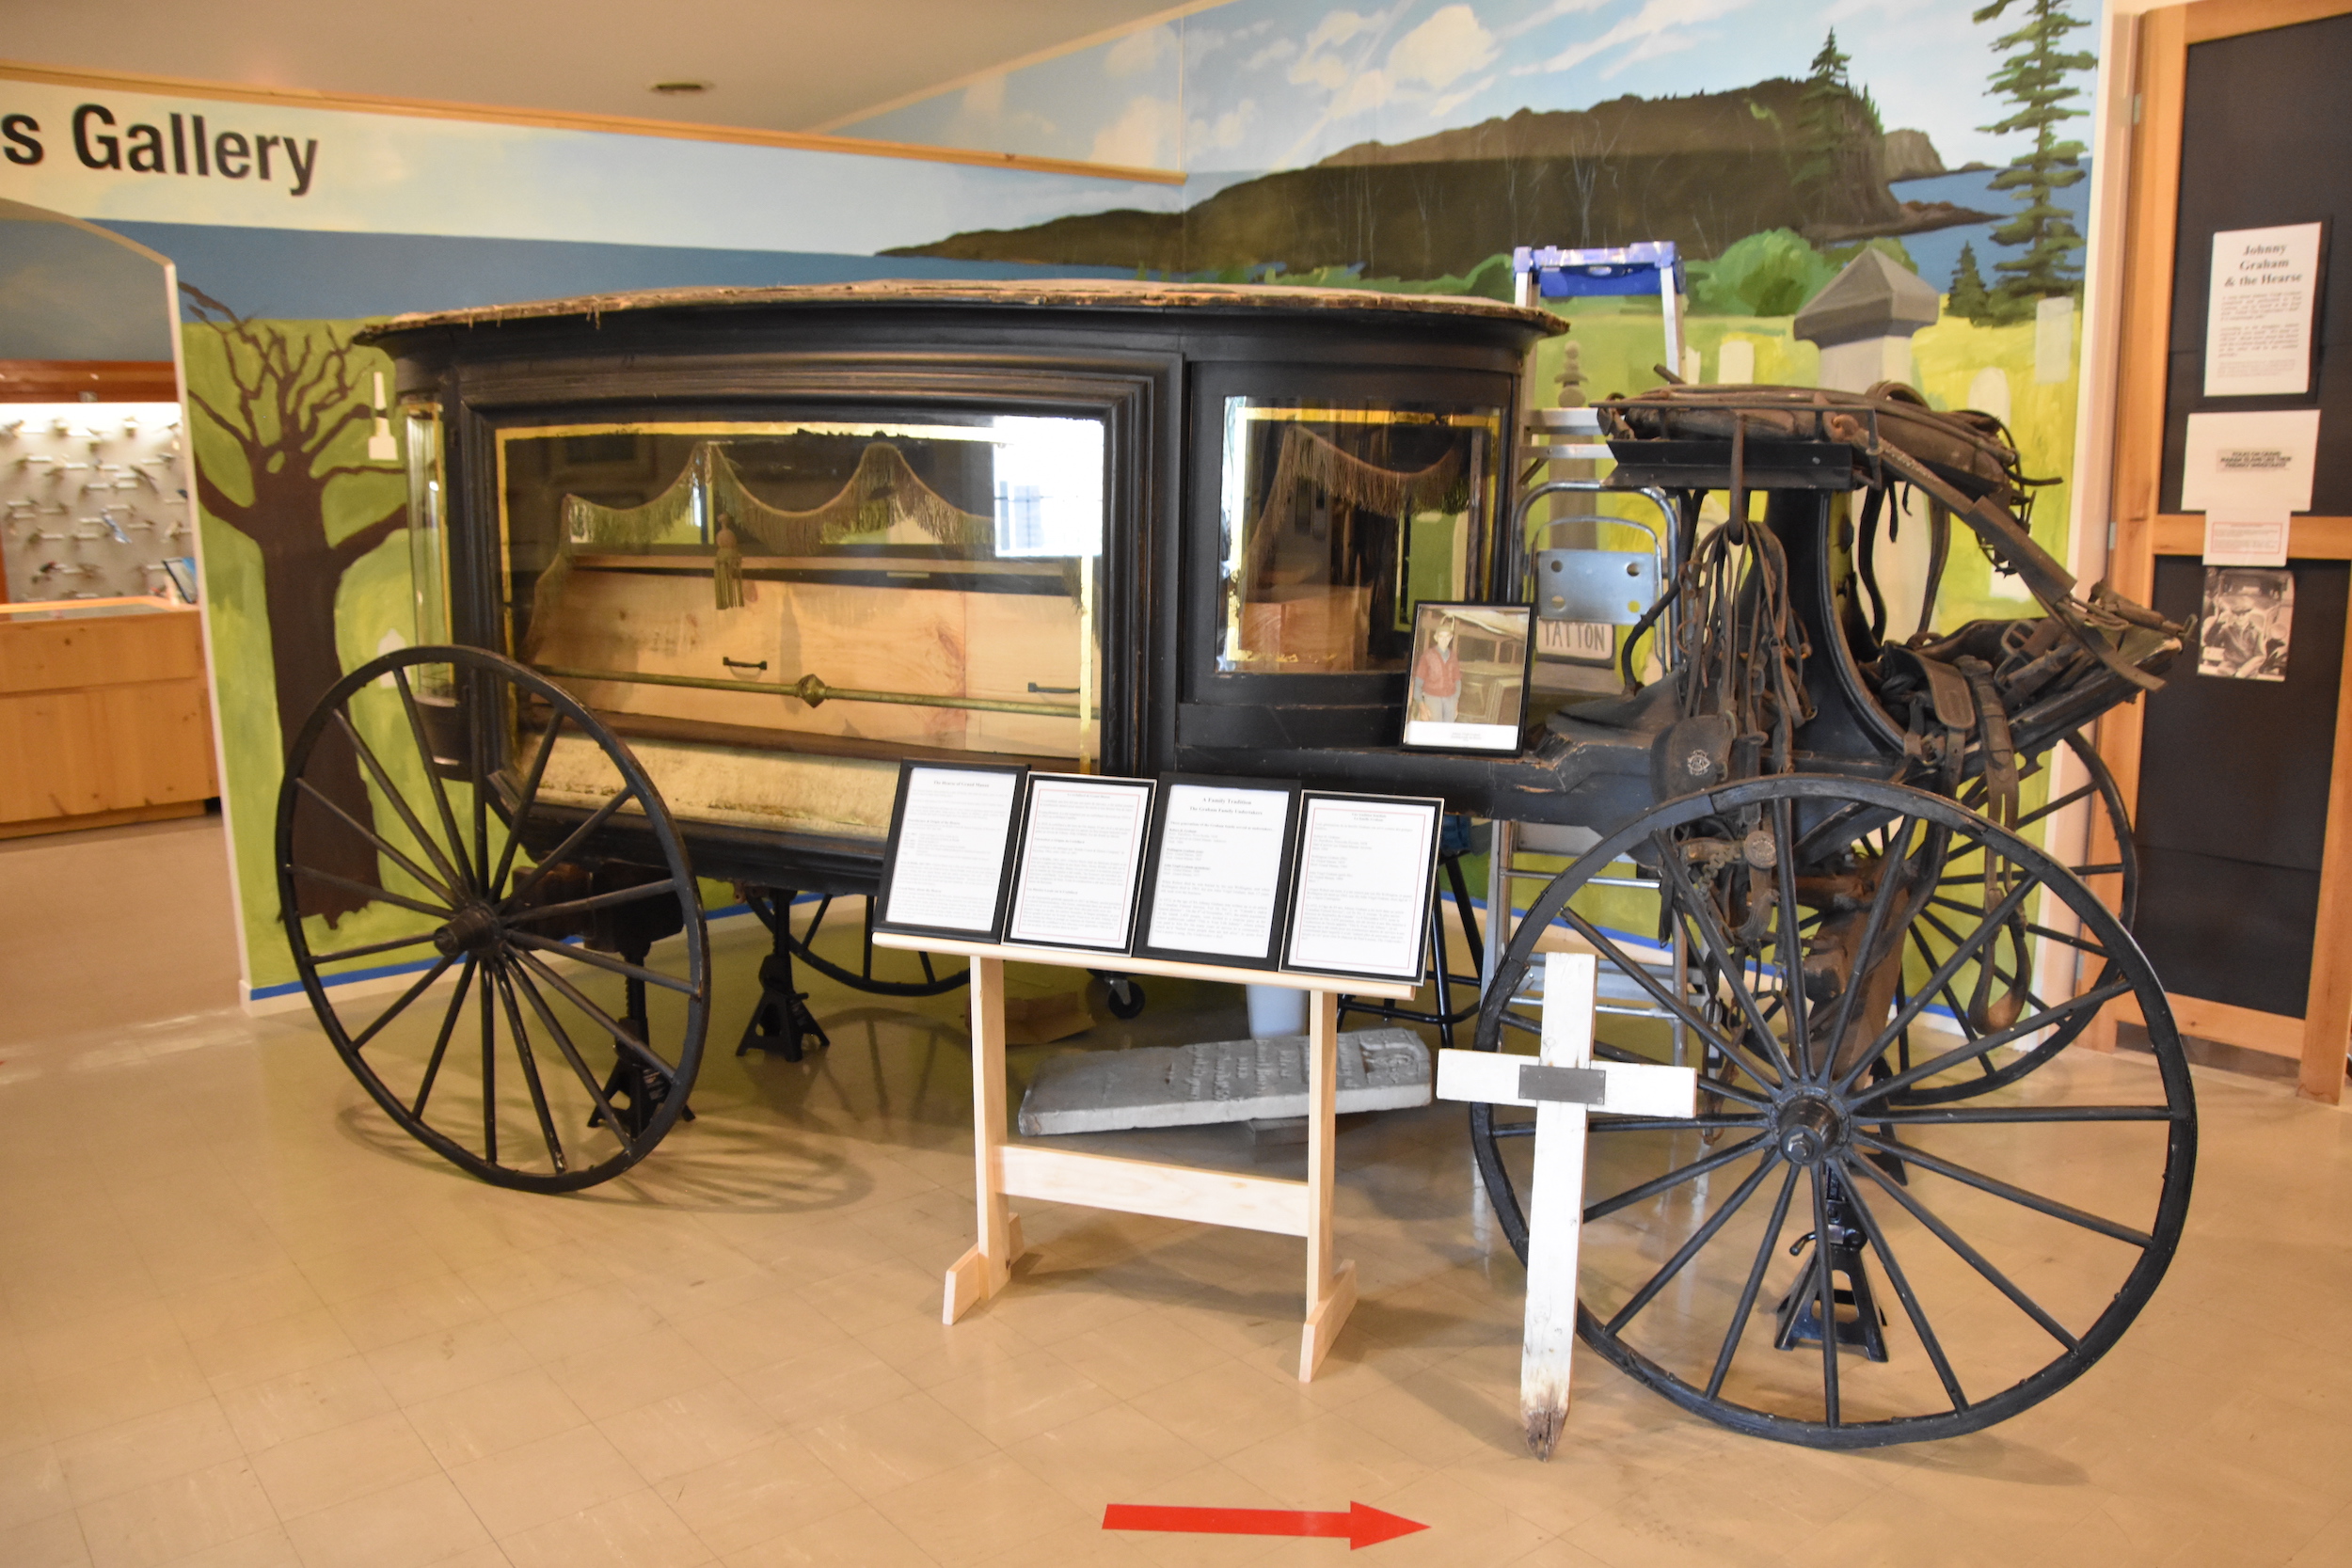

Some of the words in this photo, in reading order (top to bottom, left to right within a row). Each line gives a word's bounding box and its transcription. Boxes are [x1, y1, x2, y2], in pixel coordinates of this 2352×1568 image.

[1, 113, 44, 166] s
[72, 103, 318, 197] Gallery
[2243, 242, 2286, 258] Johnny
[2239, 257, 2289, 270] Graham
[2224, 276, 2235, 287] &
[2239, 274, 2257, 286] the
[2261, 271, 2301, 284] Hearse
